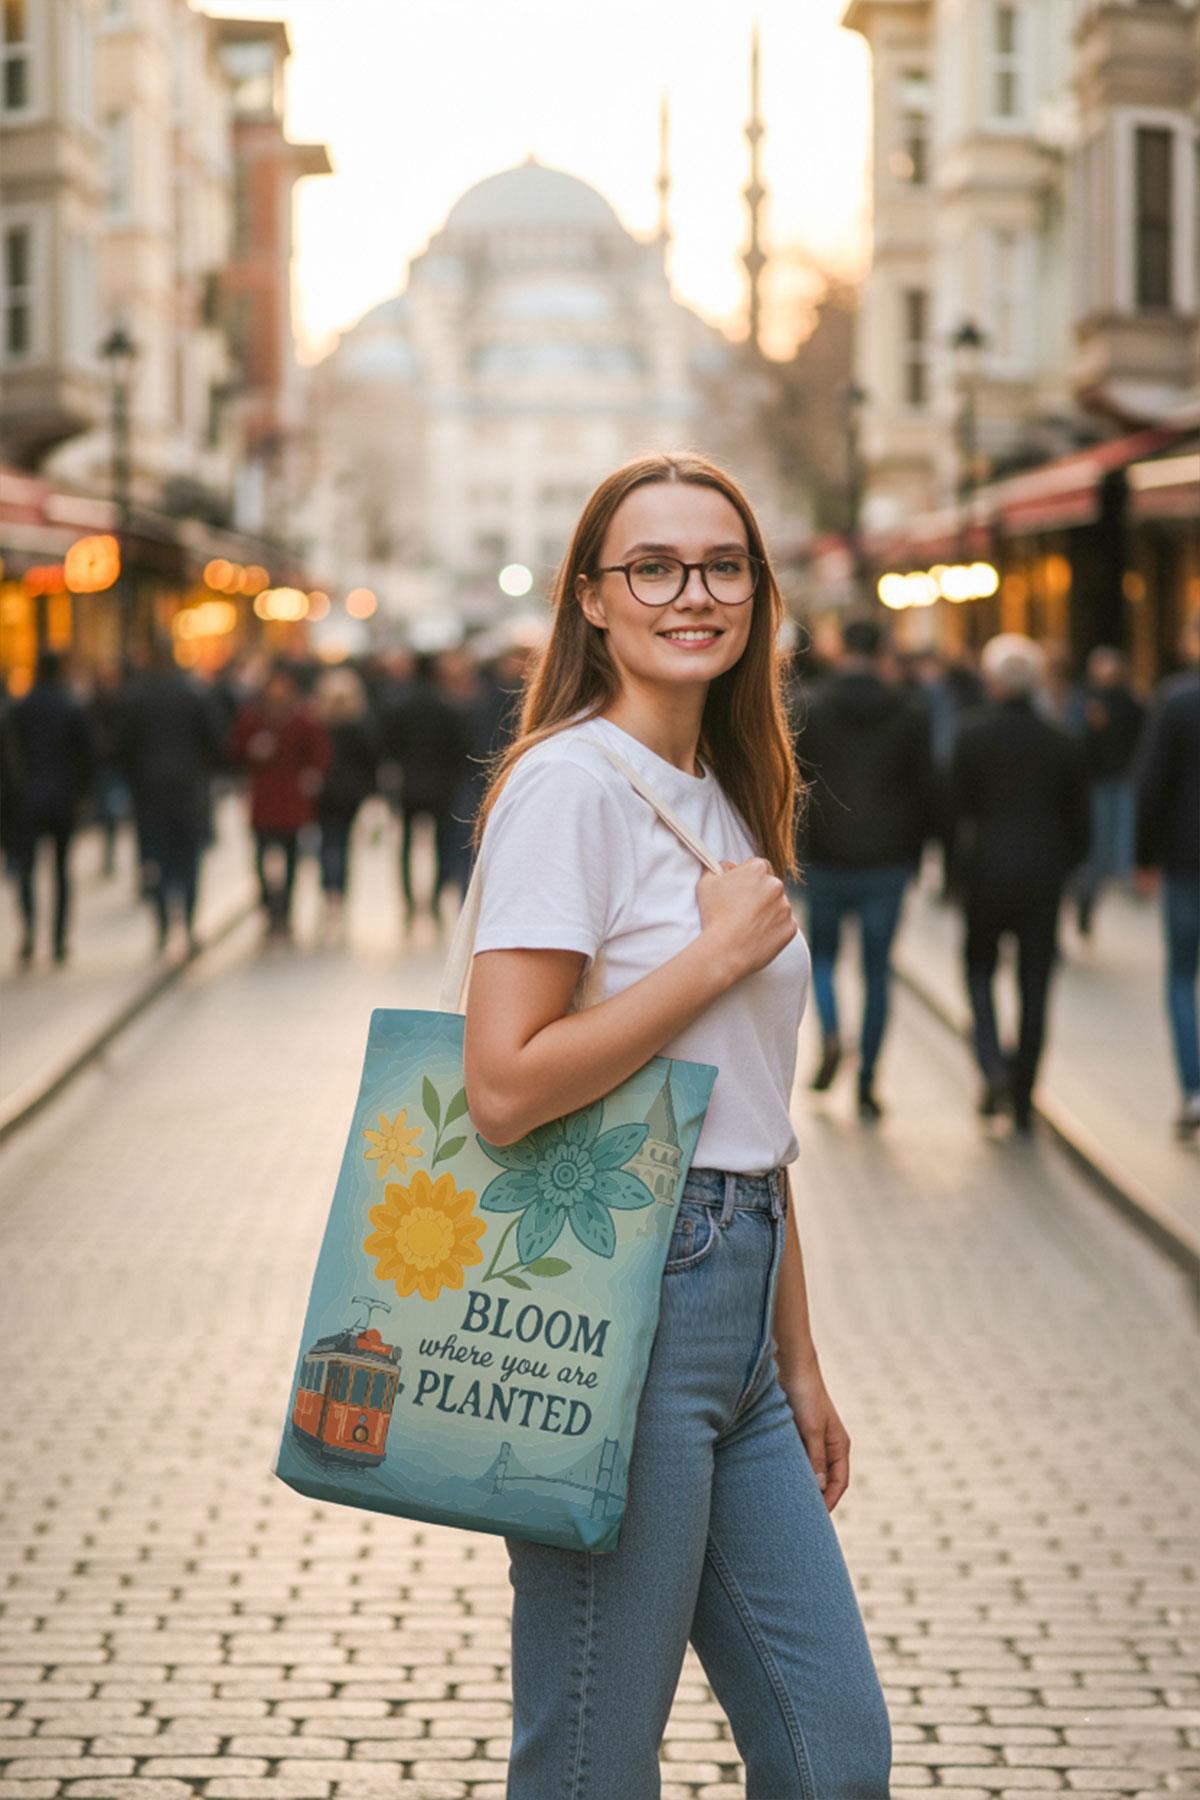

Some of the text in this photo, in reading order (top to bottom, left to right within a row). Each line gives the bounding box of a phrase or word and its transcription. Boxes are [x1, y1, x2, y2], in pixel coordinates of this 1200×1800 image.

[461, 1291, 610, 1357] BLOOM
[419, 1335, 599, 1389] where you are
[412, 1369, 592, 1436] PLANTED
